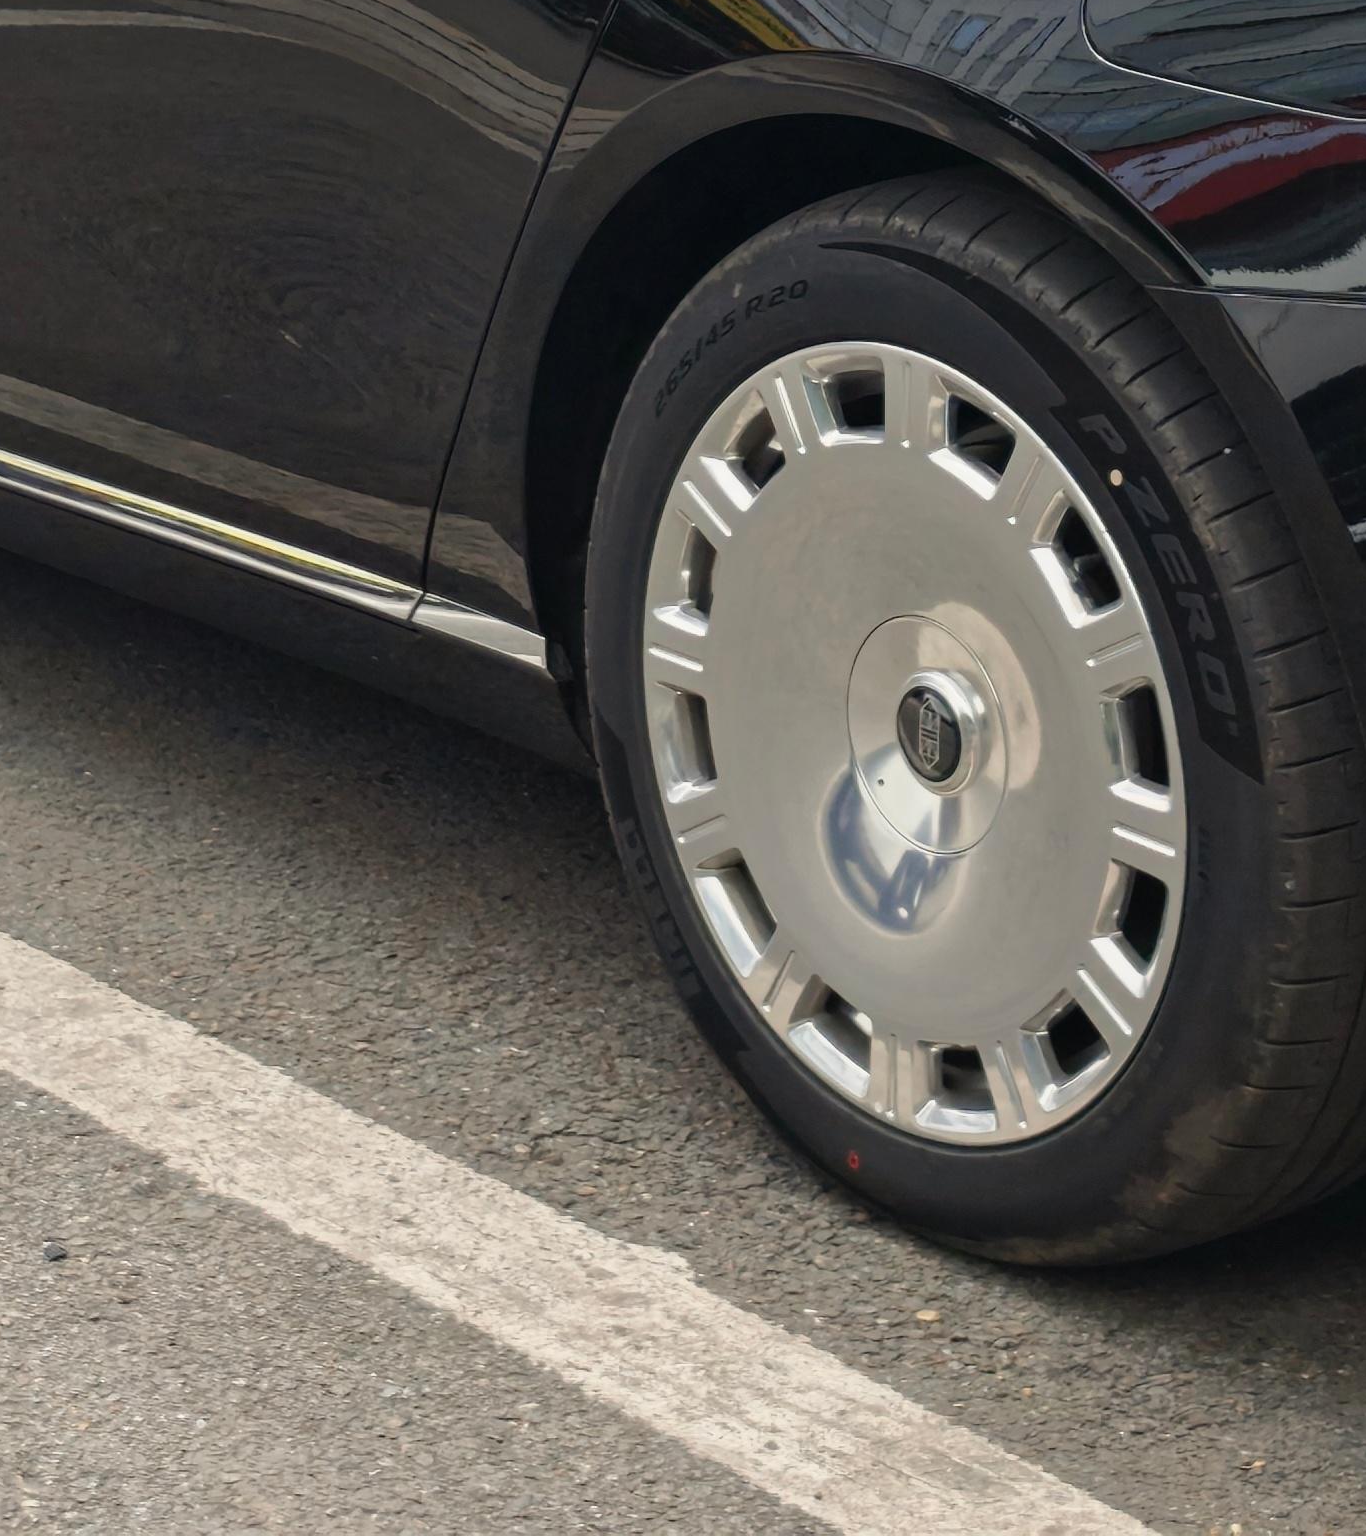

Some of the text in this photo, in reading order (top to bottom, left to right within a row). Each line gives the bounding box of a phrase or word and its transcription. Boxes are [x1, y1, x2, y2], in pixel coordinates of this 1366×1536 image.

[653, 279, 810, 419] 265/45 R20
[1078, 413, 1237, 716] P ZERO
